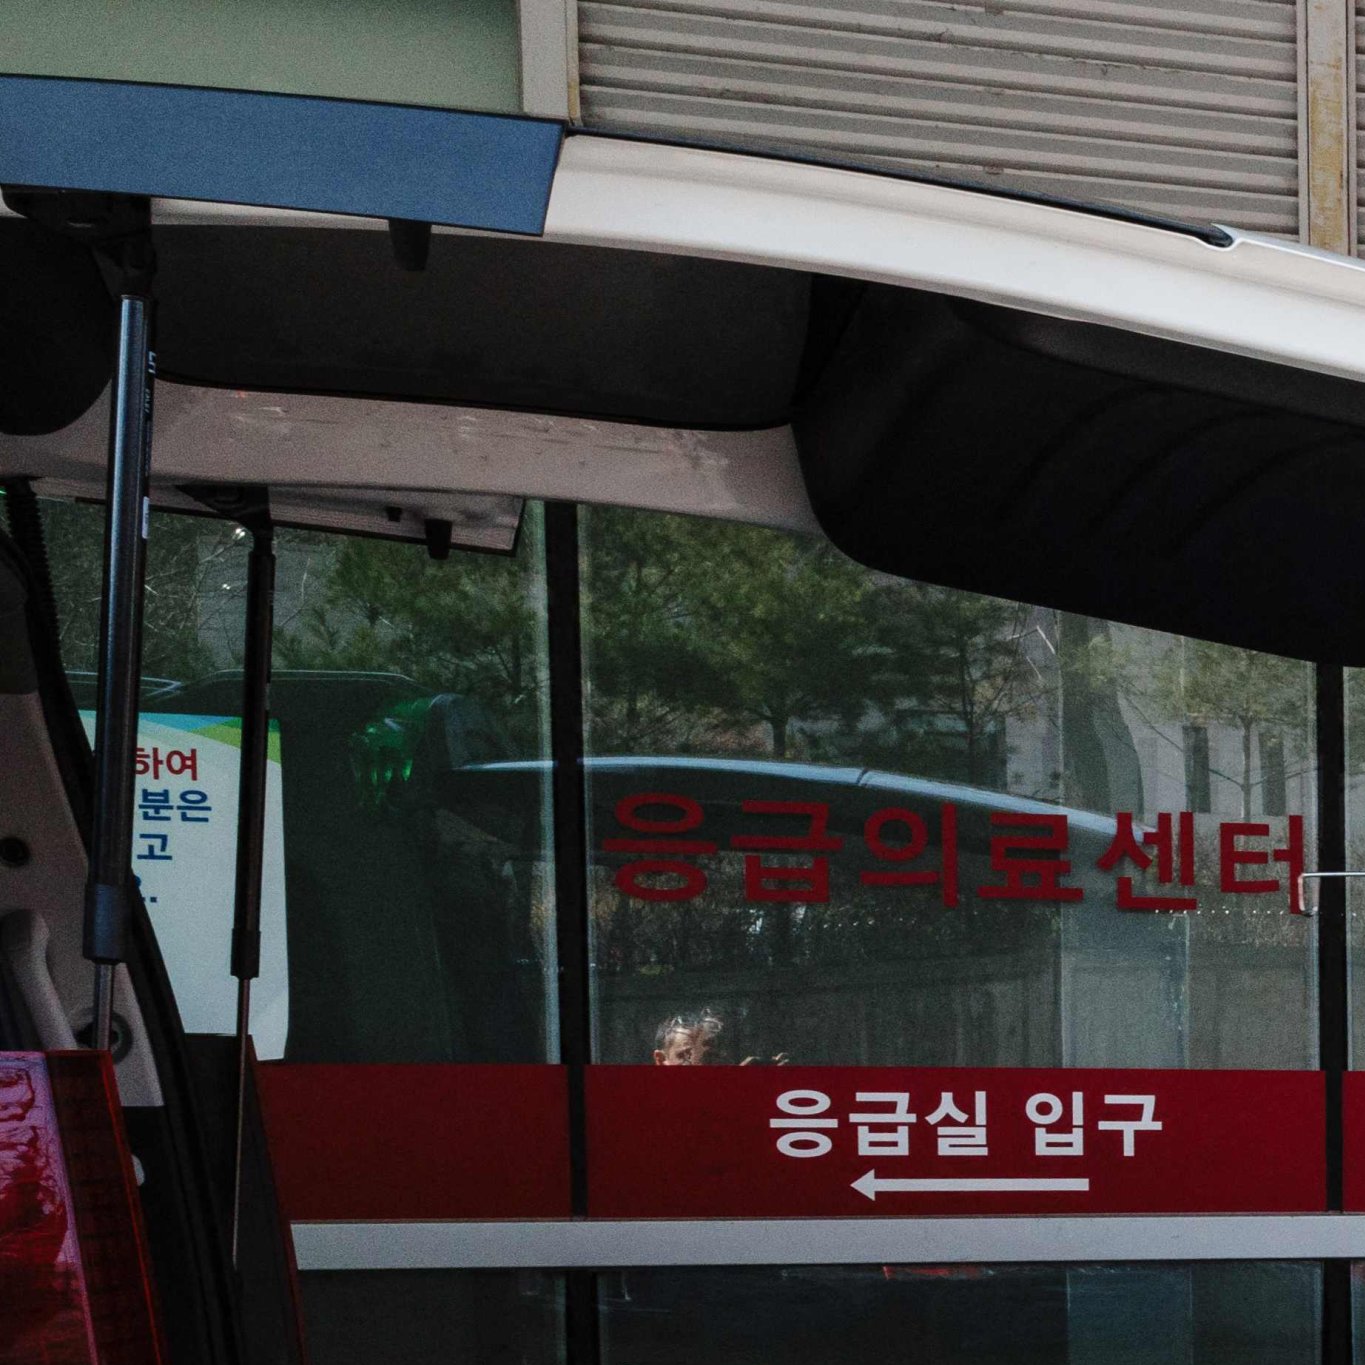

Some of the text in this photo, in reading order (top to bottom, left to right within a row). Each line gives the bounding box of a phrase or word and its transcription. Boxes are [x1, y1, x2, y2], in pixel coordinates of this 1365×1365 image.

[602, 792, 1304, 914] 응급의료센터
[768, 1089, 1164, 1159] 응급실 입구
